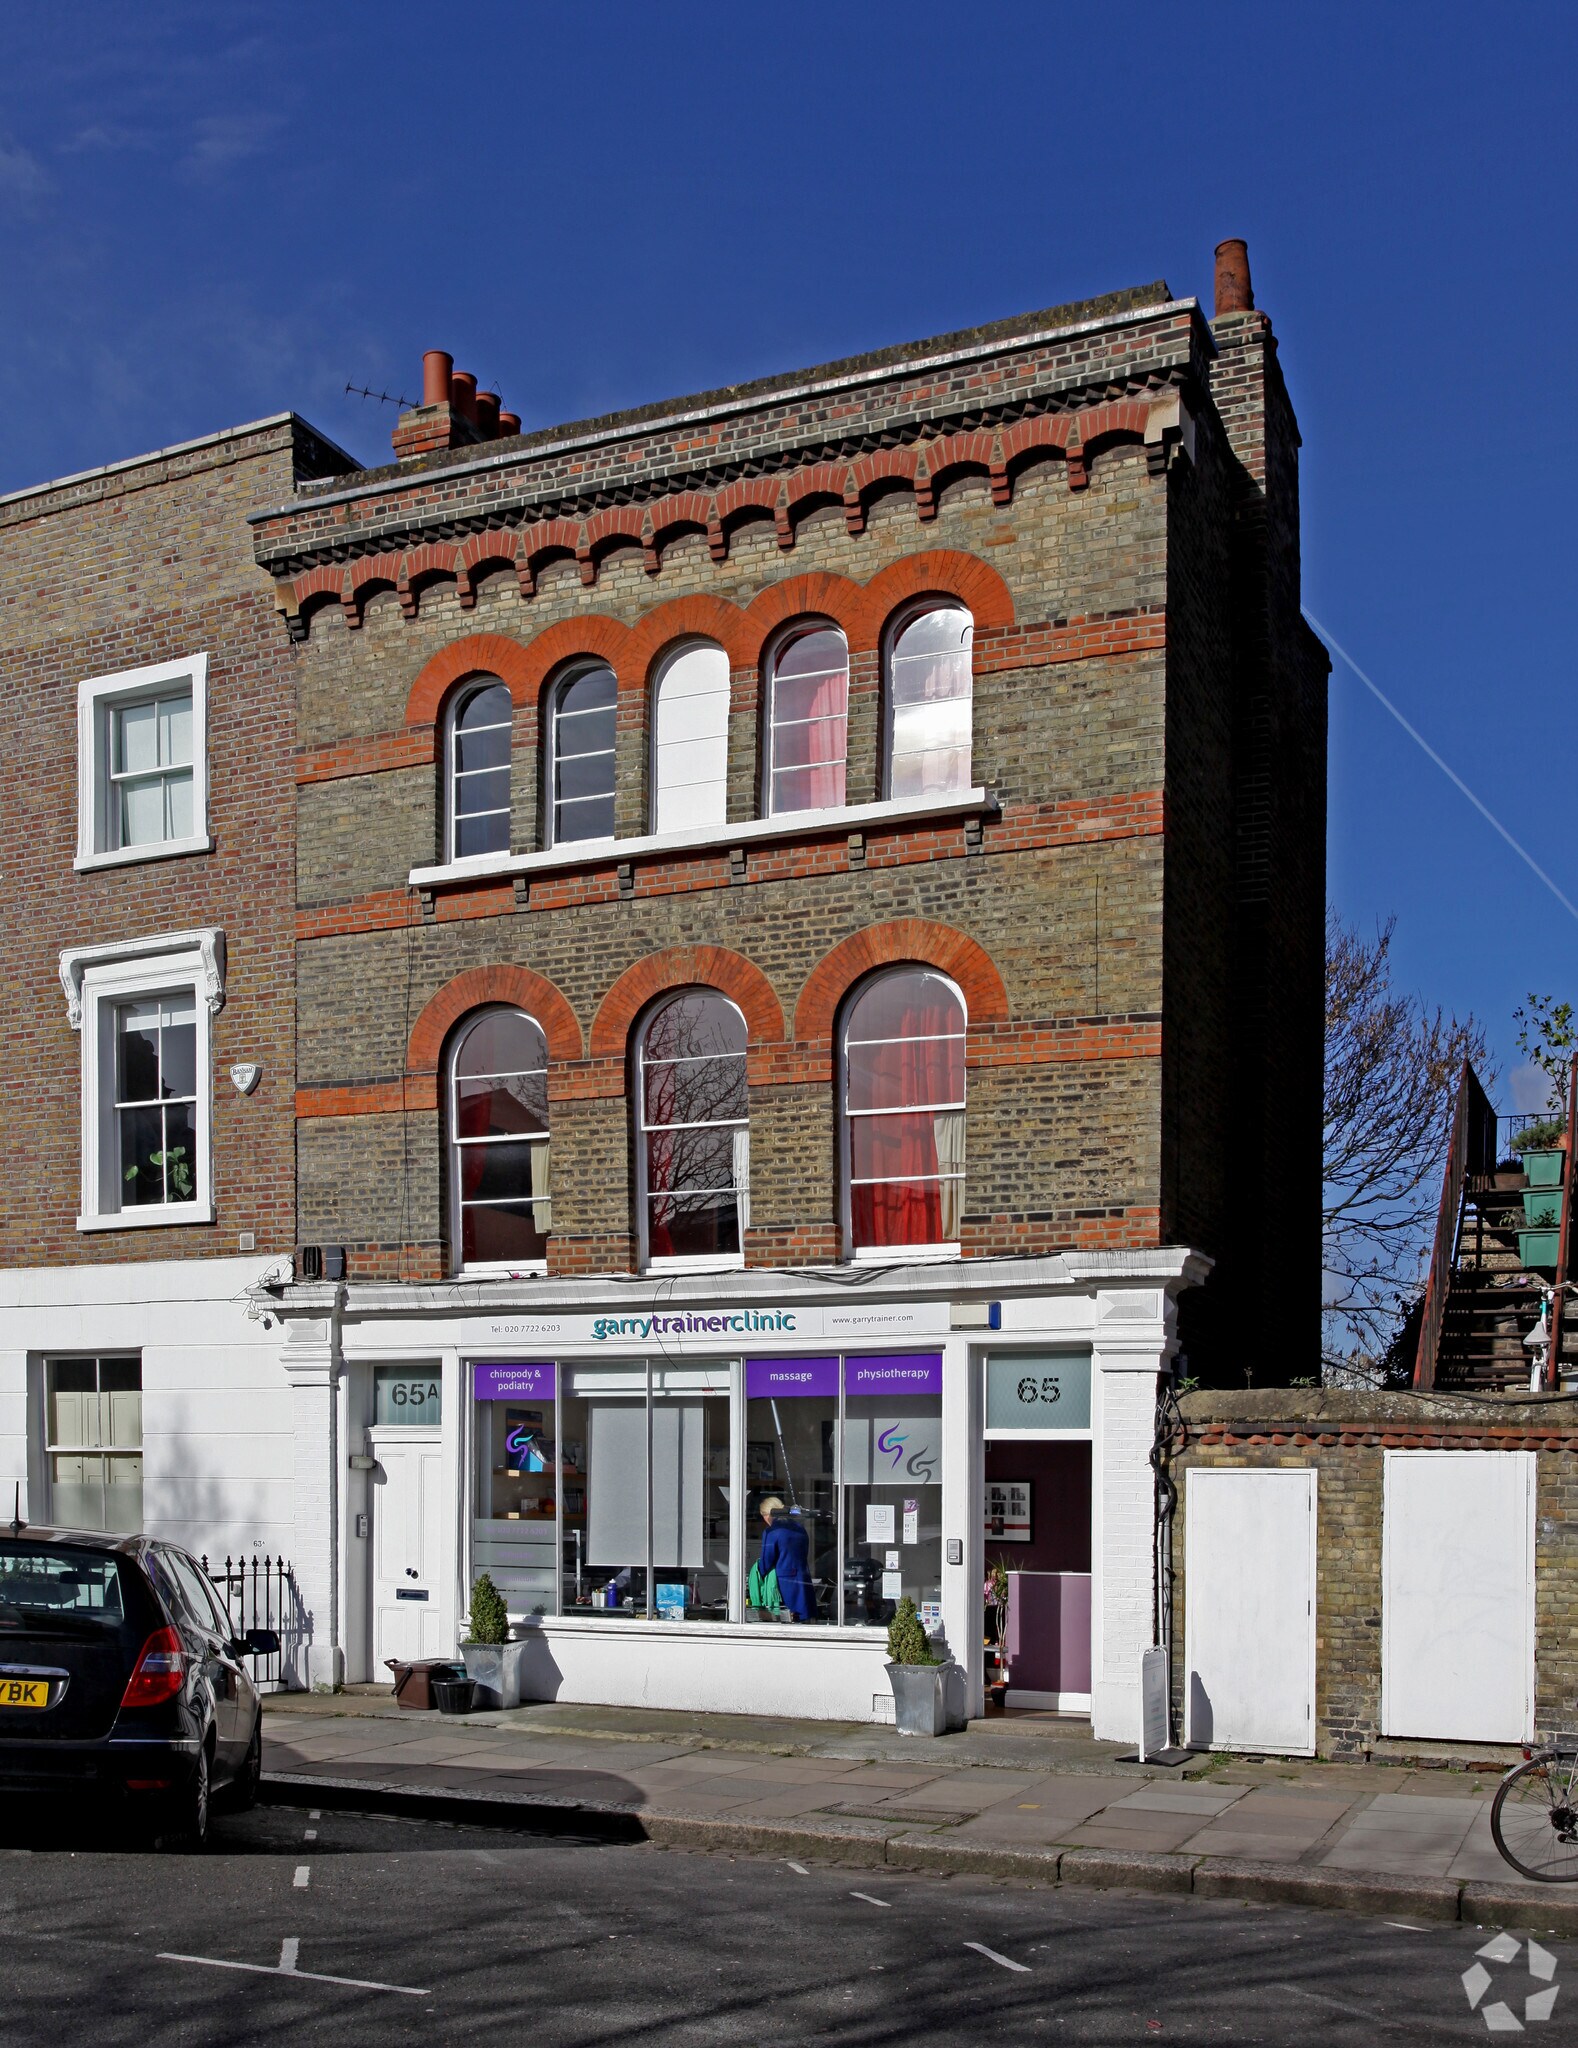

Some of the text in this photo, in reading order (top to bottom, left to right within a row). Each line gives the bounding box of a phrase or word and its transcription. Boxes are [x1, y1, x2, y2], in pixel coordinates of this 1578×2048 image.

[590, 1310, 797, 1340] garrytrainerclinic
[831, 1315, 914, 1325] www.garrytrainer.com
[491, 1324, 561, 1333] Tel: 020 7722 6203
[490, 1369, 542, 1380] chiropody &
[769, 1371, 813, 1382] massage
[857, 1368, 930, 1381] physiotherapy
[498, 1381, 534, 1392] podiatry
[1017, 1377, 1061, 1404] 65
[391, 1383, 439, 1406] 65A
